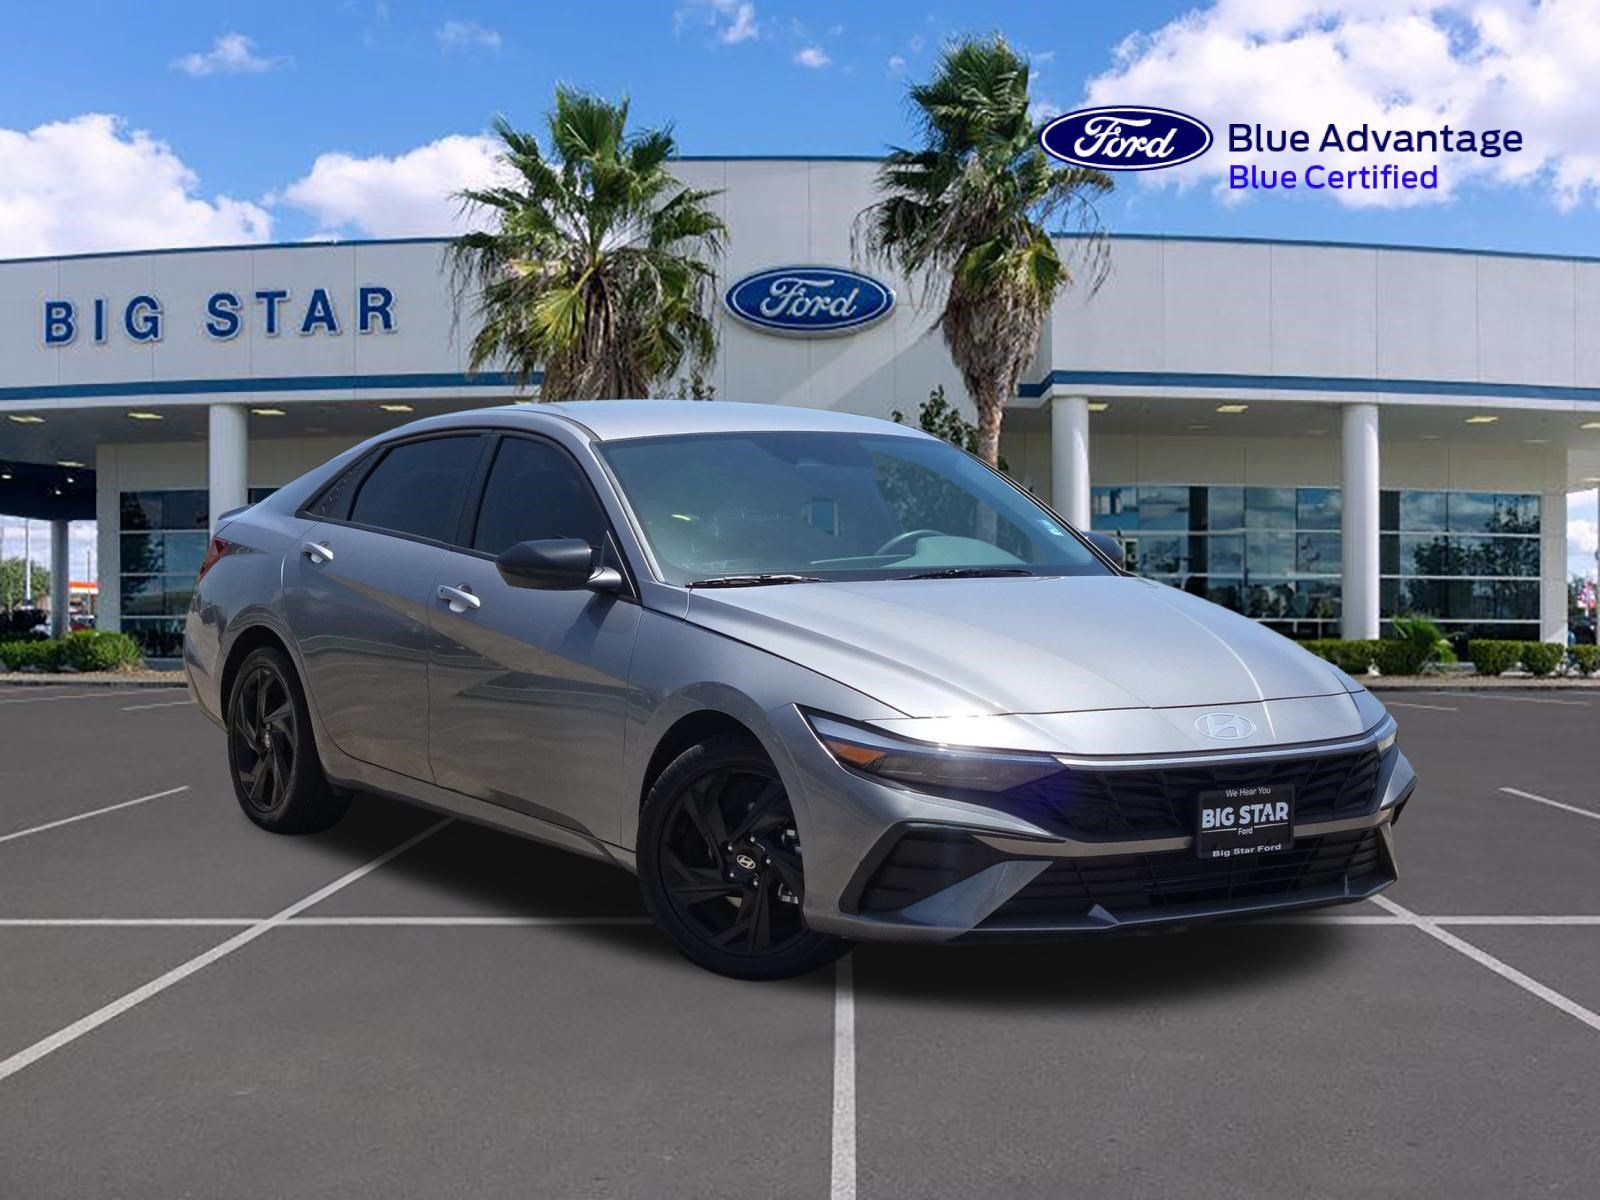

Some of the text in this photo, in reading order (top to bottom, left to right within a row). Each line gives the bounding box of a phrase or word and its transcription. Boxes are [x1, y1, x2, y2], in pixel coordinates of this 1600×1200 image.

[760, 277, 859, 318] Ford
[44, 286, 397, 345] BIG STAR
[1225, 786, 1271, 798] We Hear You
[1201, 801, 1289, 829] BIG STAR
[1237, 826, 1253, 836] Ford
[1212, 843, 1282, 858] Big Star Ford
